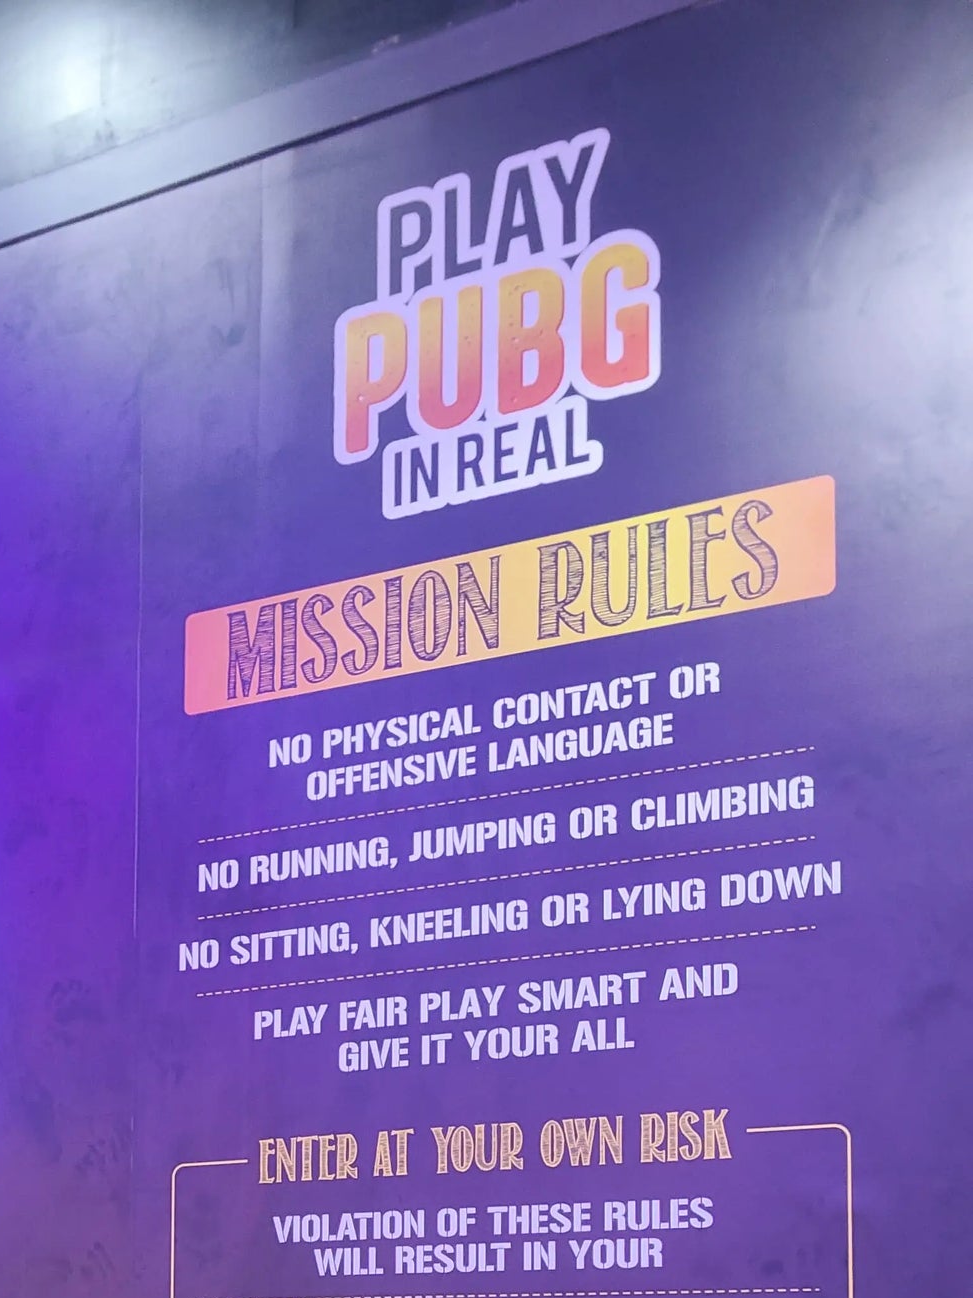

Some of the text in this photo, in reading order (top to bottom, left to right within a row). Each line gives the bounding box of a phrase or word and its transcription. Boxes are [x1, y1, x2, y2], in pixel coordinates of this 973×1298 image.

[388, 144, 598, 296] PLAY
[342, 241, 651, 456] PUBG
[393, 406, 592, 510] IN REAL
[227, 500, 780, 700] MISSION RULES
[270, 662, 720, 767] NO PHYSICAL CONTACT OR
[307, 713, 674, 802] OFFENSIVE LANGUAGE
[199, 776, 814, 892] NO RUNNING, JUMPING OR CLIMBING
[179, 861, 841, 971] NO SITTING, KNEELING OR LYING DOWN
[255, 963, 737, 1039] PLAY FAIR PLAY SMART AND
[339, 1018, 634, 1072] GIVE IT YOUR ALL
[258, 1108, 732, 1184] ENTER AT YOUR OWN RISK
[273, 1198, 713, 1243] VIOLATION OF THESE RULES
[314, 1238, 662, 1276] WILL RESULT IN YOUR
